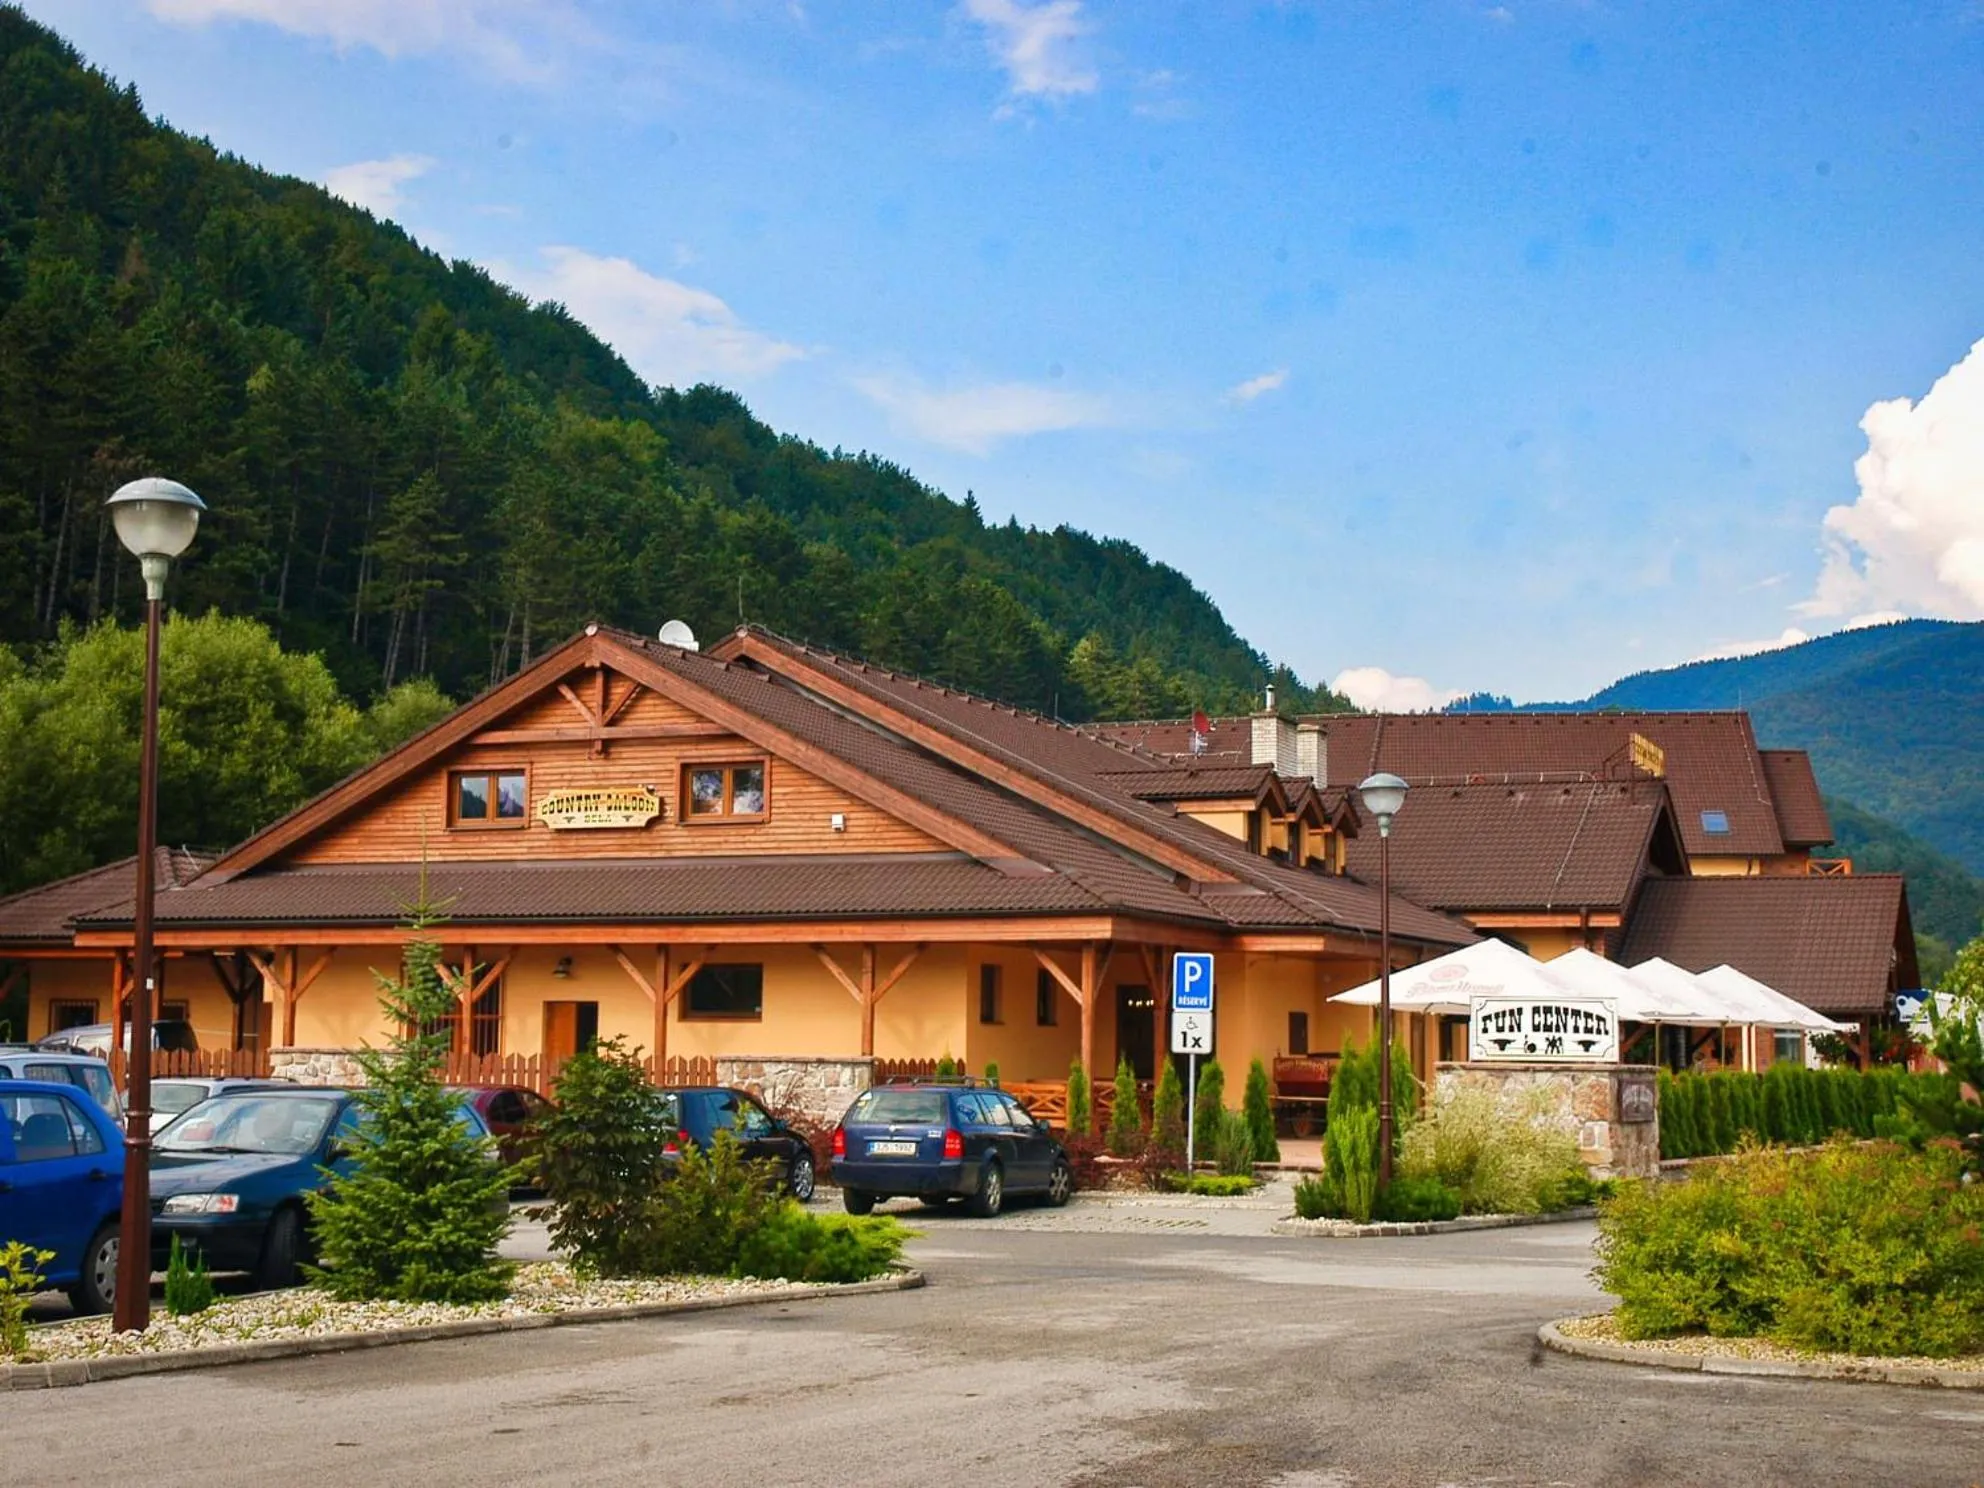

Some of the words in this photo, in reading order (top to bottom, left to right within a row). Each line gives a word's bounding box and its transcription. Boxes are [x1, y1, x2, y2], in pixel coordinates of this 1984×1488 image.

[541, 793, 601, 816] COUNTRY
[606, 793, 656, 812] SALOON
[1184, 960, 1202, 993] P
[1481, 1007, 1524, 1034] FUN
[1532, 1006, 1609, 1036] CENTER
